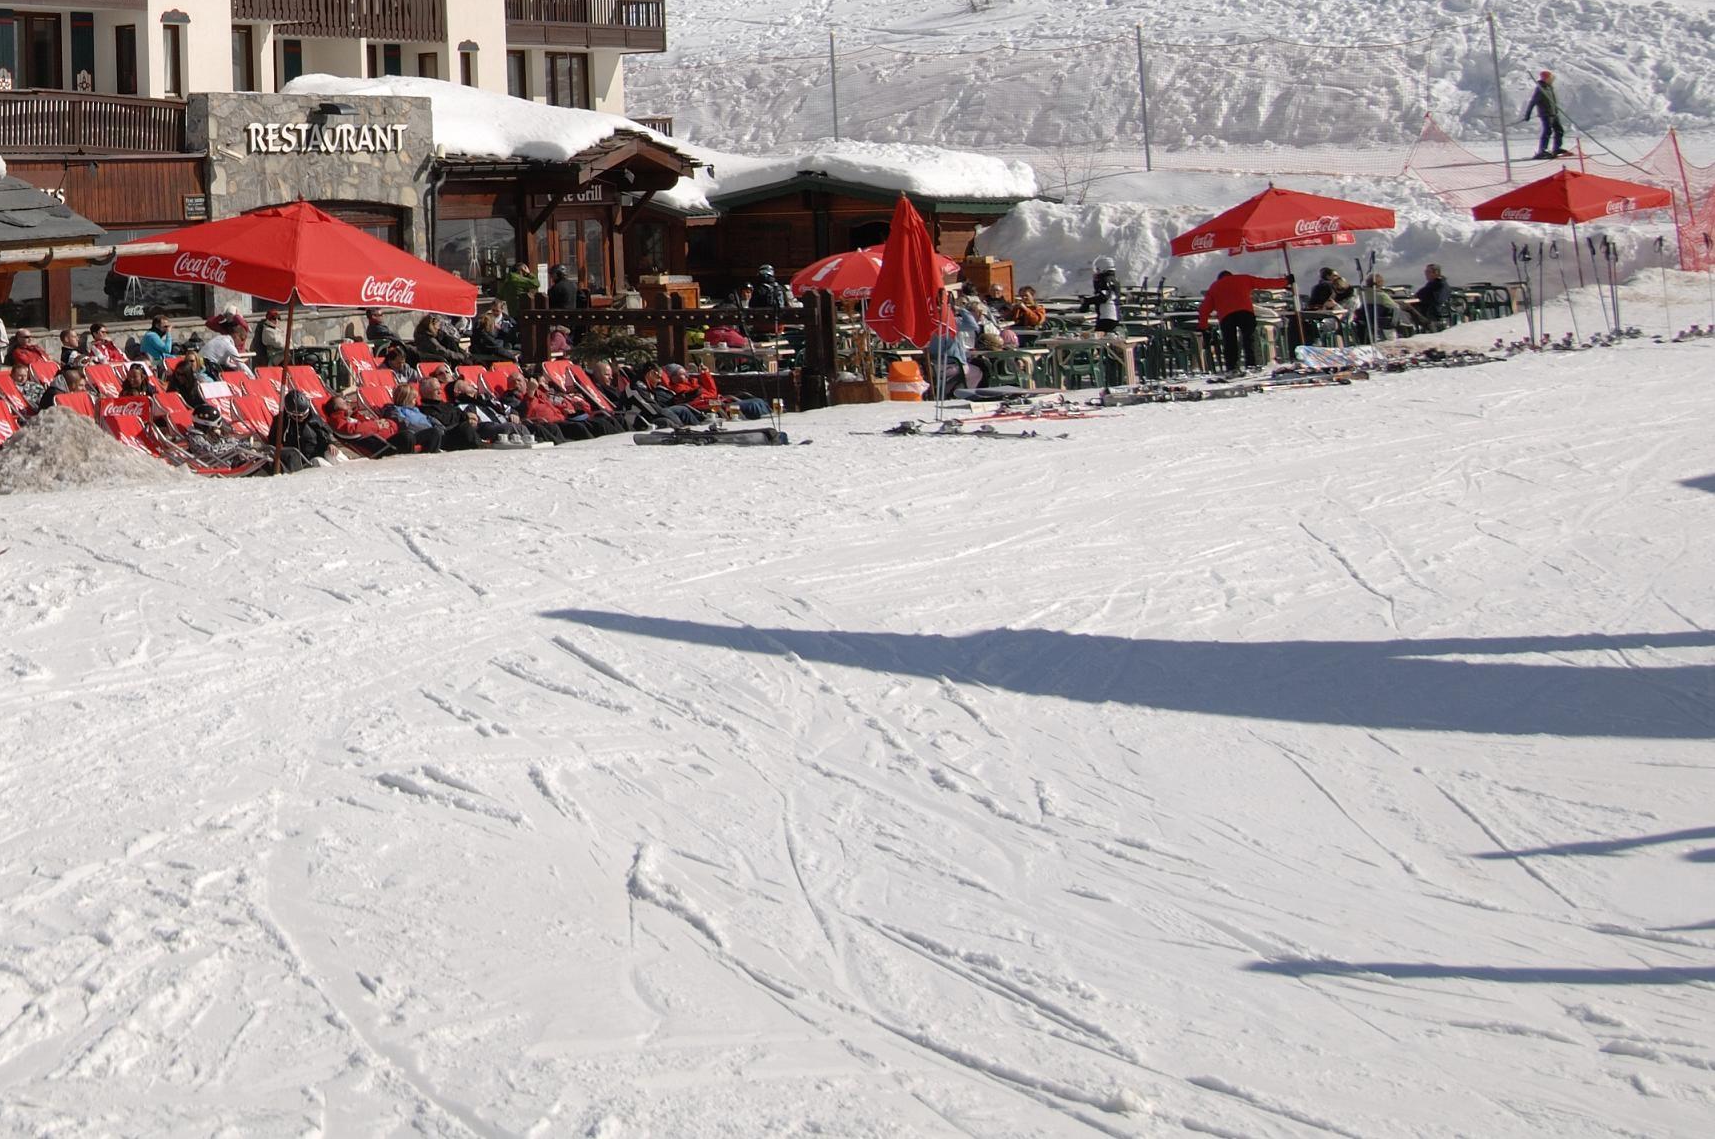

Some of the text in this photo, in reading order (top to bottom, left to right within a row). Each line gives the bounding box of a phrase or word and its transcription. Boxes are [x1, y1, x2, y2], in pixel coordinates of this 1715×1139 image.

[246, 122, 409, 154] RESTAURANT
[1294, 215, 1340, 236] Coca-Cola
[173, 251, 233, 284] Coca-Cola
[361, 275, 417, 305] Coca-Cola
[103, 400, 146, 417] Coca-Cola
